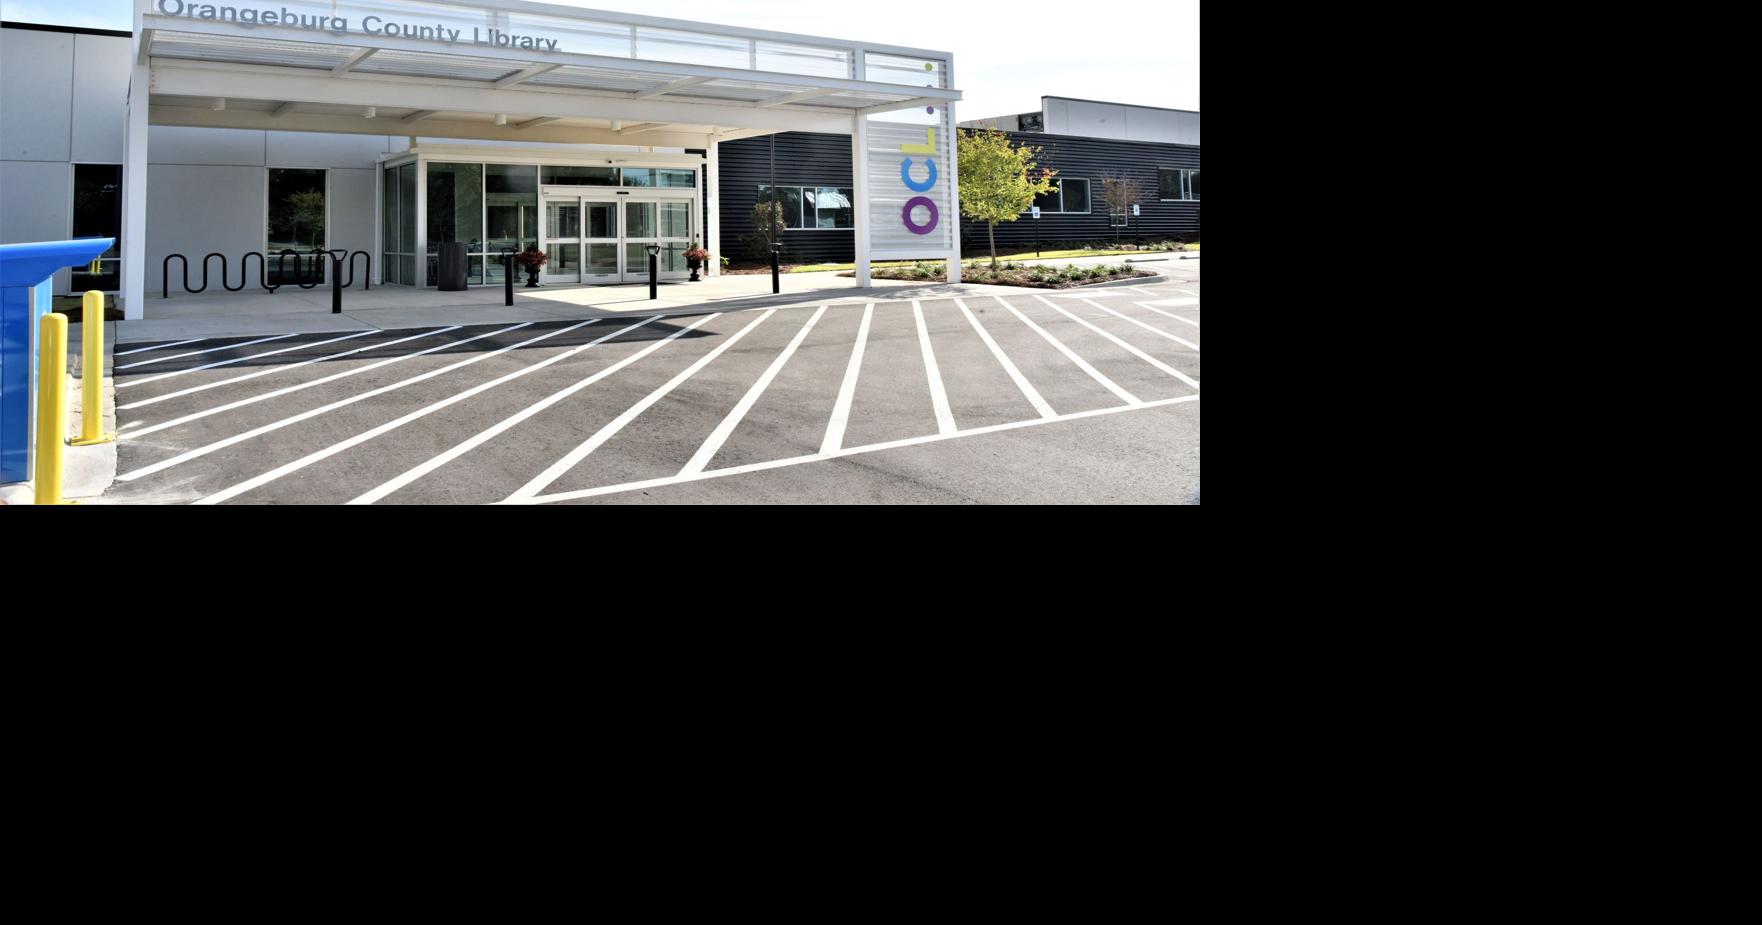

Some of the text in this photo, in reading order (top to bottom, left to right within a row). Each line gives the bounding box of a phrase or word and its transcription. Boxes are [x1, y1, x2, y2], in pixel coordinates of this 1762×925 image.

[158, 0, 558, 55] Orangeburg County Library
